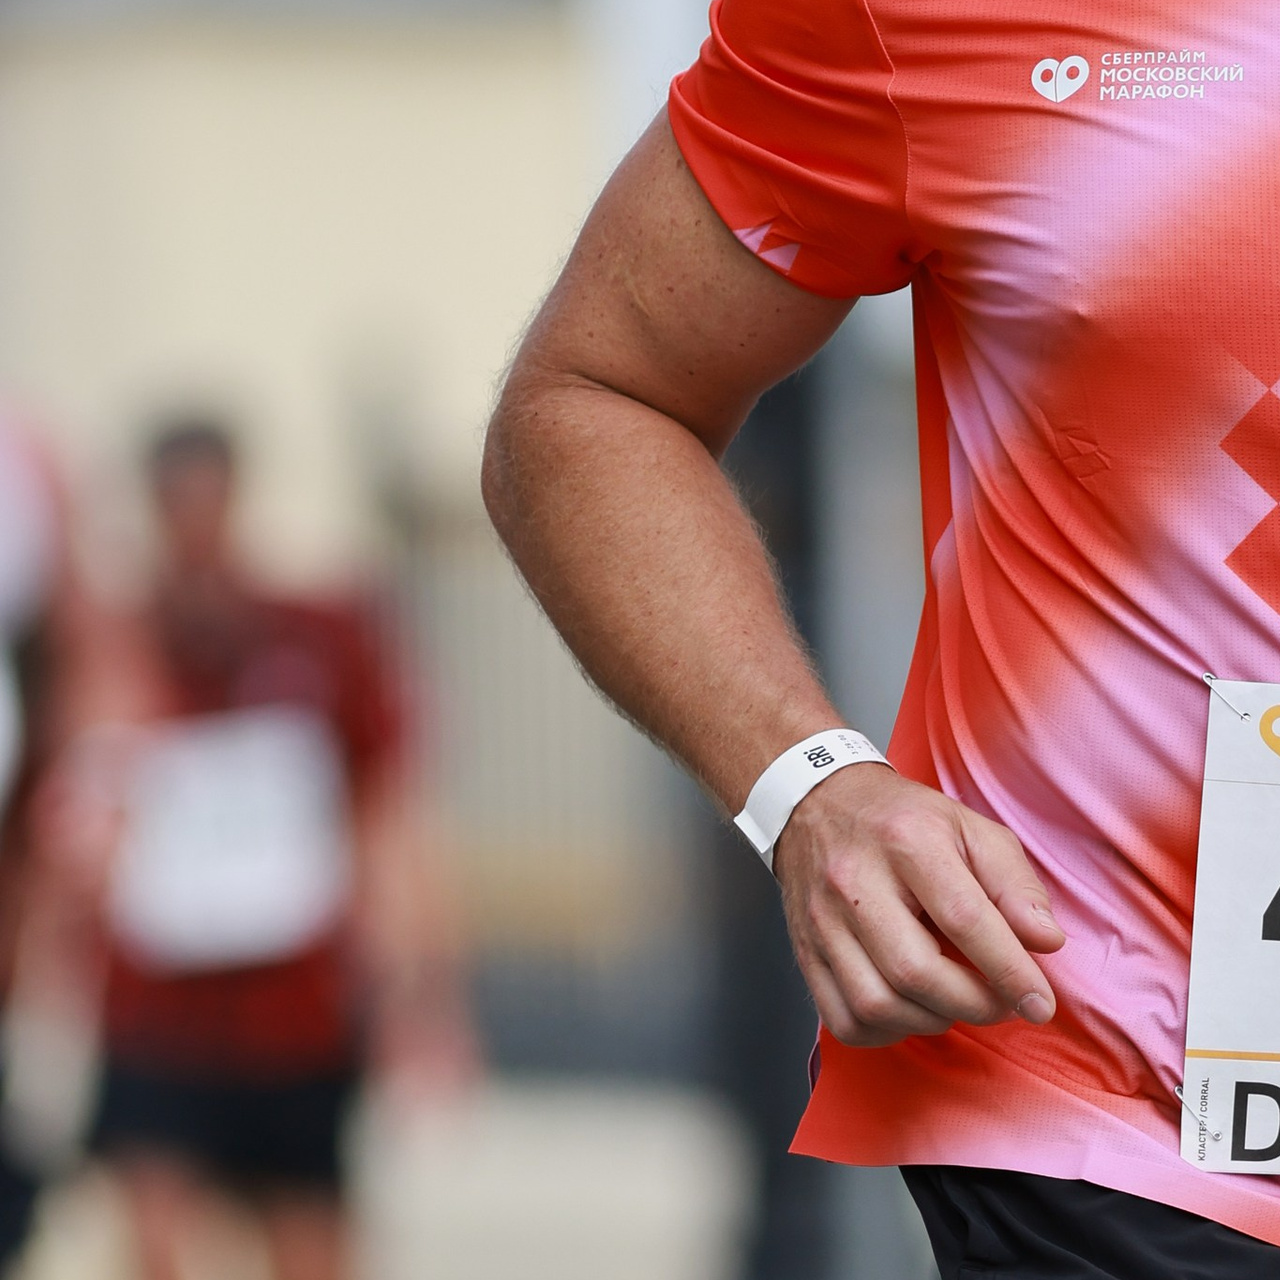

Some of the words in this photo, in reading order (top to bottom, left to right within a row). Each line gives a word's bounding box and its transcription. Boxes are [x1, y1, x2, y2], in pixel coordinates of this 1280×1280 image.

[1101, 51, 1206, 66] СБЕРПРАЙМ
[1100, 64, 1244, 83] МОСКОВСКИЙ
[1100, 84, 1205, 101] МАРАФОН
[1200, 1078, 1210, 1112] CORRAL
